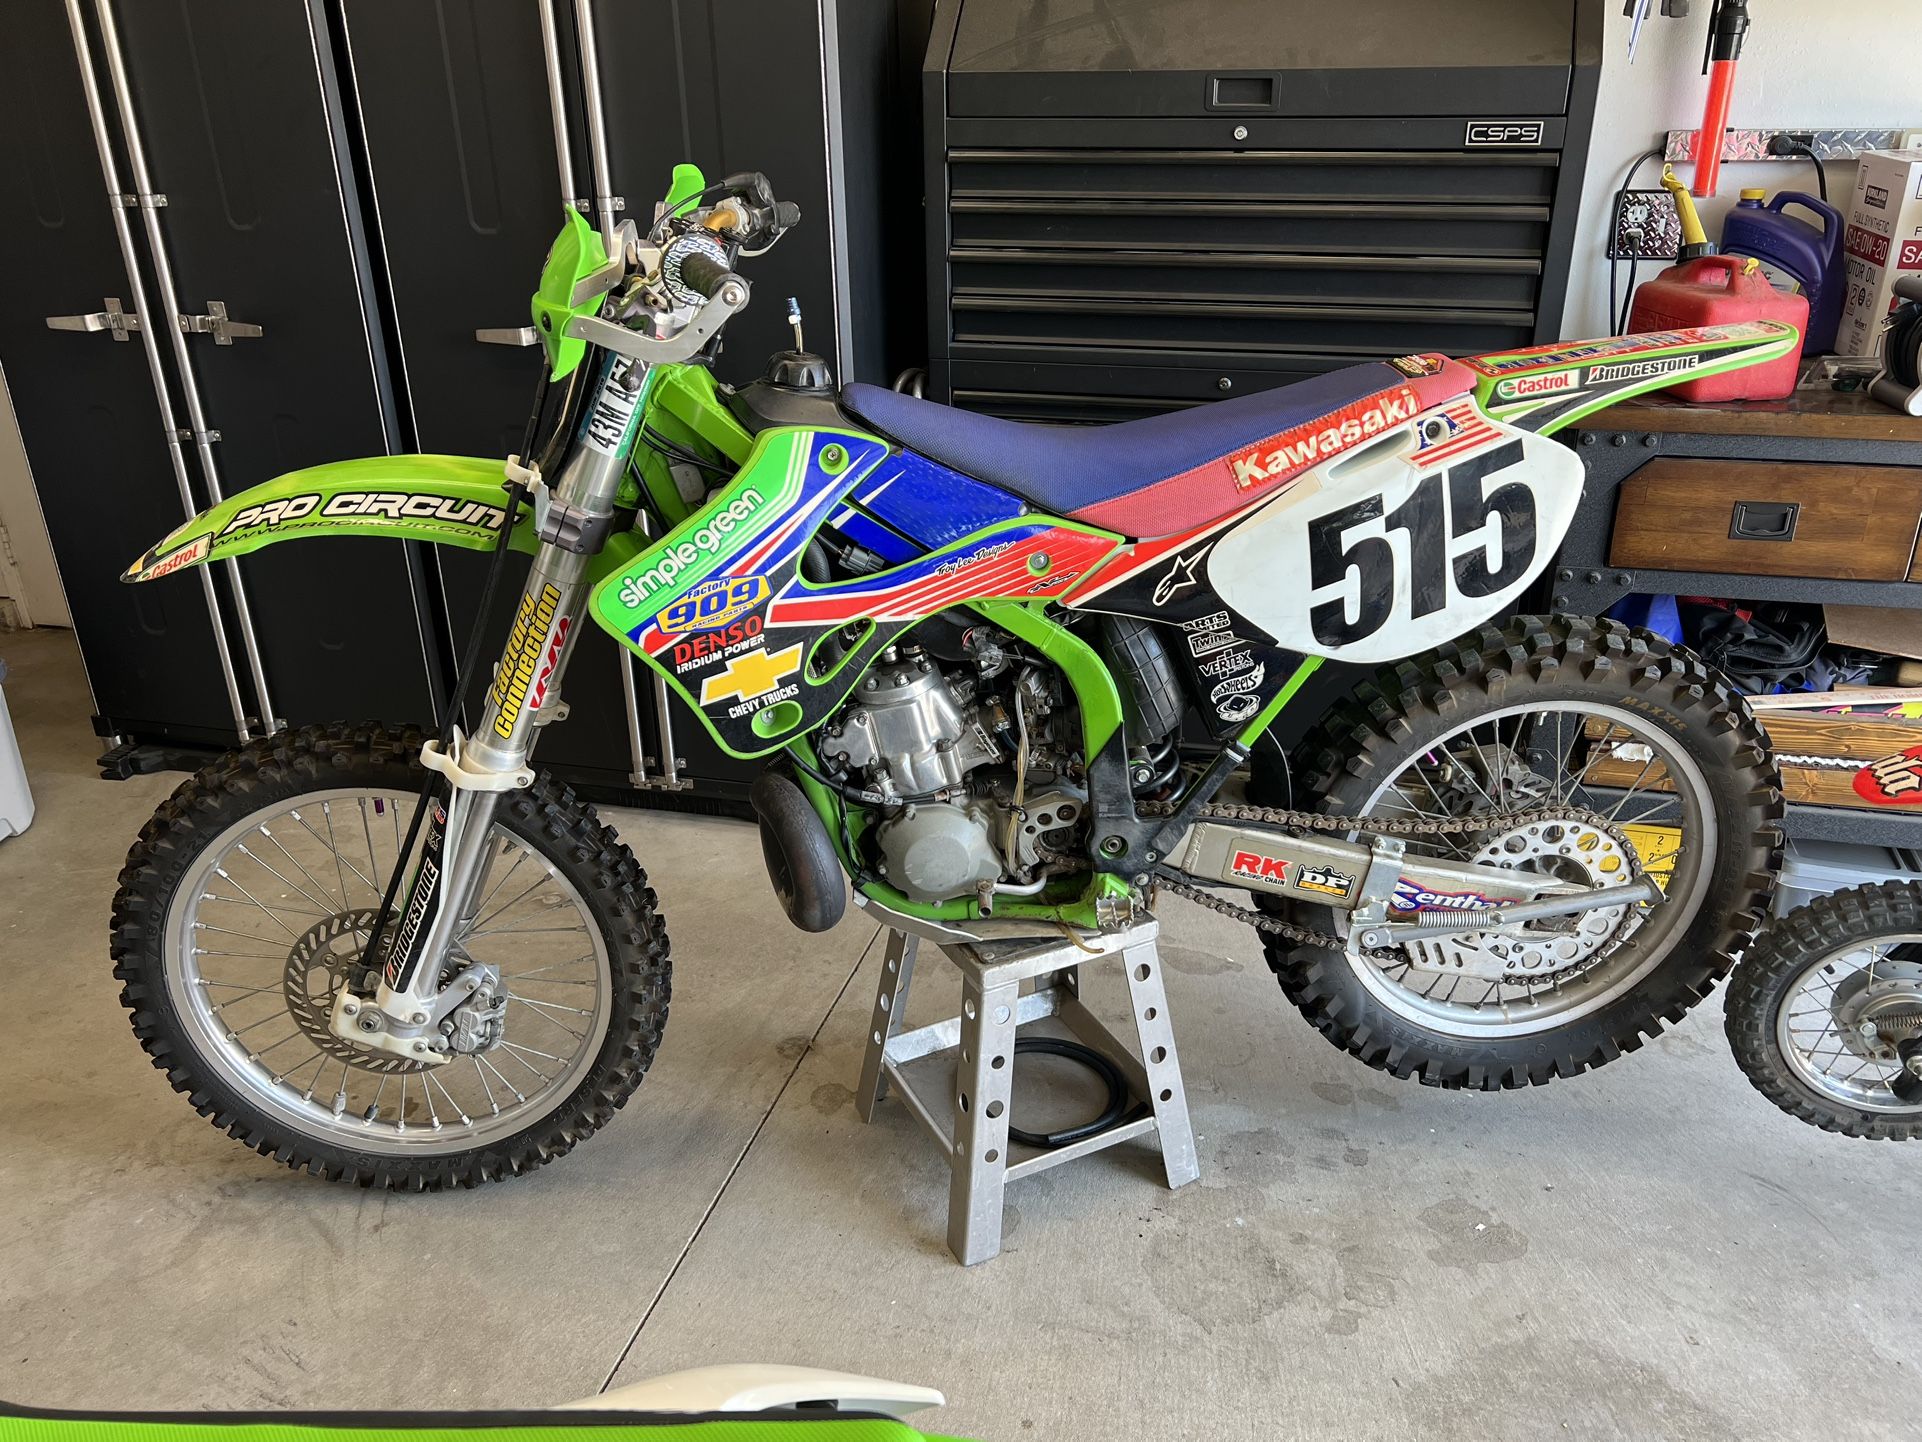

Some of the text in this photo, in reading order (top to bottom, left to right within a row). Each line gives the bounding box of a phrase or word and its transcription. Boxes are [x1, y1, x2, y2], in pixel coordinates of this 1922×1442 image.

[1470, 127, 1538, 141] CSPS
[1853, 211, 1890, 233] FULL SYNTHETIC
[1846, 228, 1888, 261] SAE 0W-20
[1866, 267, 1877, 285] OIL
[1517, 373, 1570, 395] Castrol
[1584, 355, 1699, 385] BRIDGESTONE
[587, 399, 630, 450] 43M
[622, 416, 635, 446] CALIFORNIA
[1231, 388, 1420, 487] Kawasaki
[221, 493, 519, 535] PRO CIRCUIT
[618, 485, 765, 609] simple green
[936, 541, 1016, 577] Troy Lee Designs
[1307, 438, 1538, 648] 515
[152, 543, 198, 580] Castrol
[667, 578, 760, 629] 909
[686, 577, 731, 599] Factory
[691, 605, 748, 628] RACING PARTS
[492, 591, 535, 705] Factory
[673, 616, 762, 665] DENSO
[676, 633, 765, 674] IRIDIUM POWER
[494, 582, 562, 739] Connection
[1199, 649, 1254, 677] VERTEX
[728, 683, 800, 719] CHEVY TRUCKS
[1618, 696, 1688, 732] MAXXIS
[1657, 835, 1665, 845] 2
[1233, 851, 1290, 880] RK
[1264, 876, 1286, 887] CHAIN
[1301, 871, 1349, 888] DP
[386, 859, 440, 991] BRIDGESTONE
[356, 1156, 462, 1169] MAXXIS
